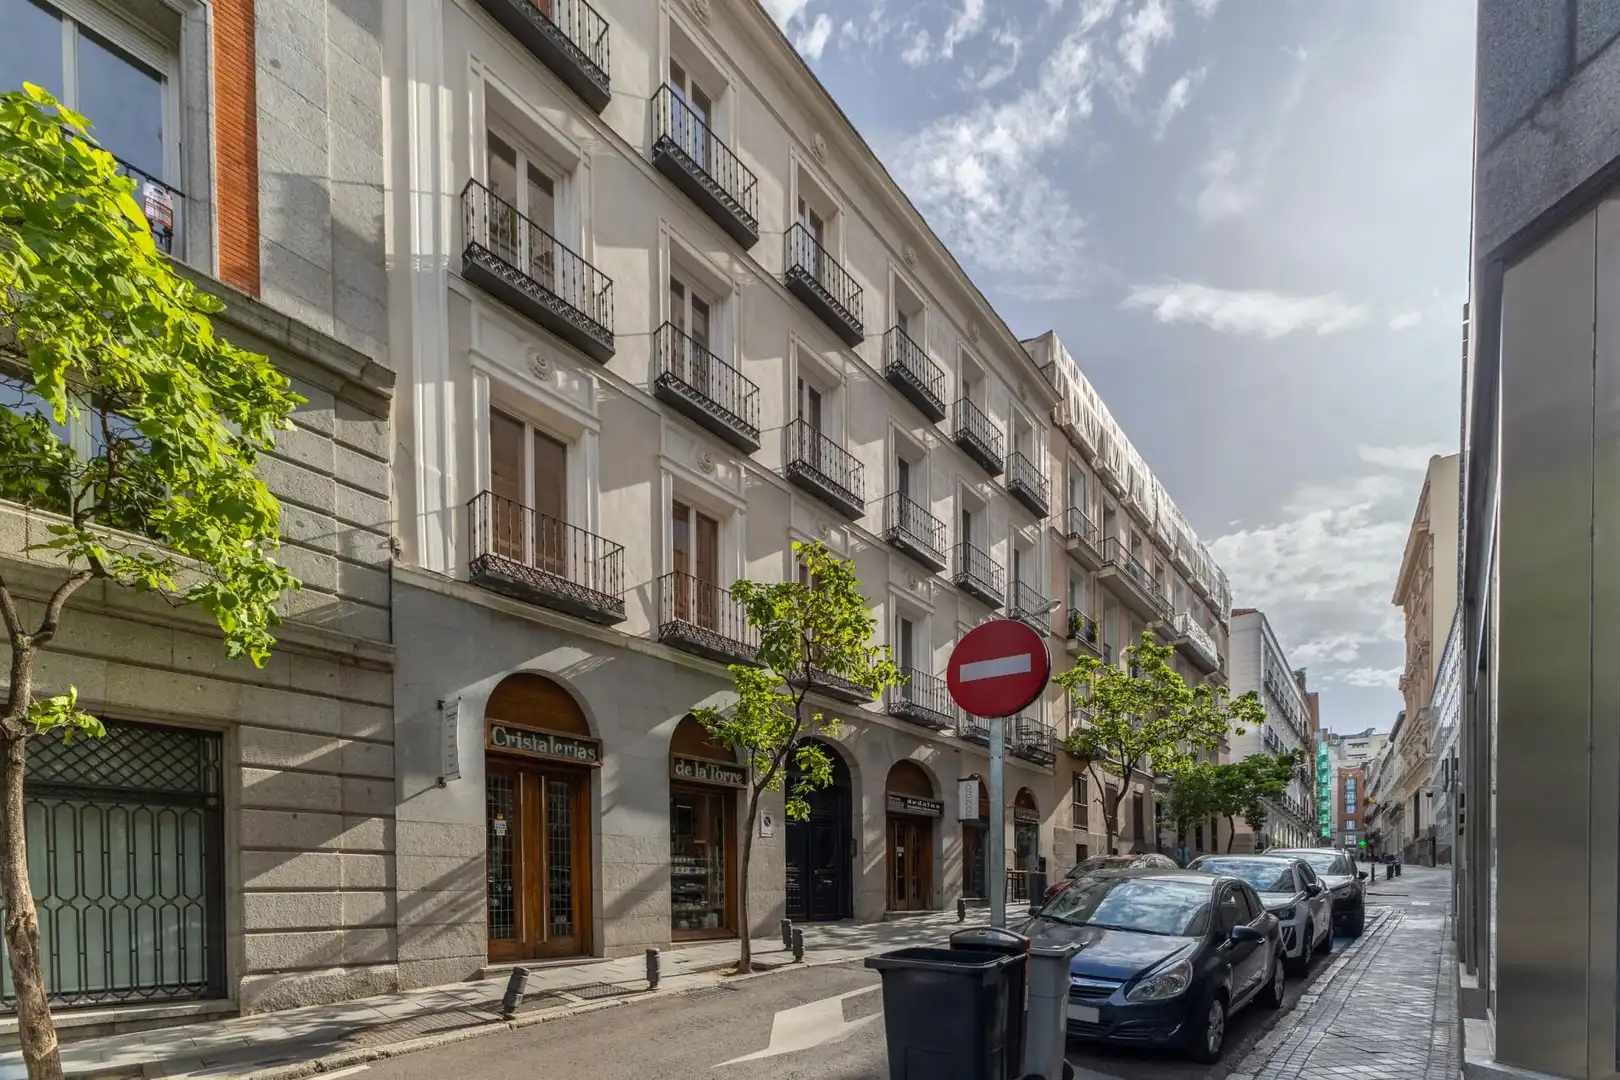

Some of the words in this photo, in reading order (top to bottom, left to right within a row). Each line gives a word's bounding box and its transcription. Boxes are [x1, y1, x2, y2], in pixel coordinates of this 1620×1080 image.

[675, 759, 692, 776] de
[694, 761, 706, 779] la
[705, 763, 743, 784] Torre
